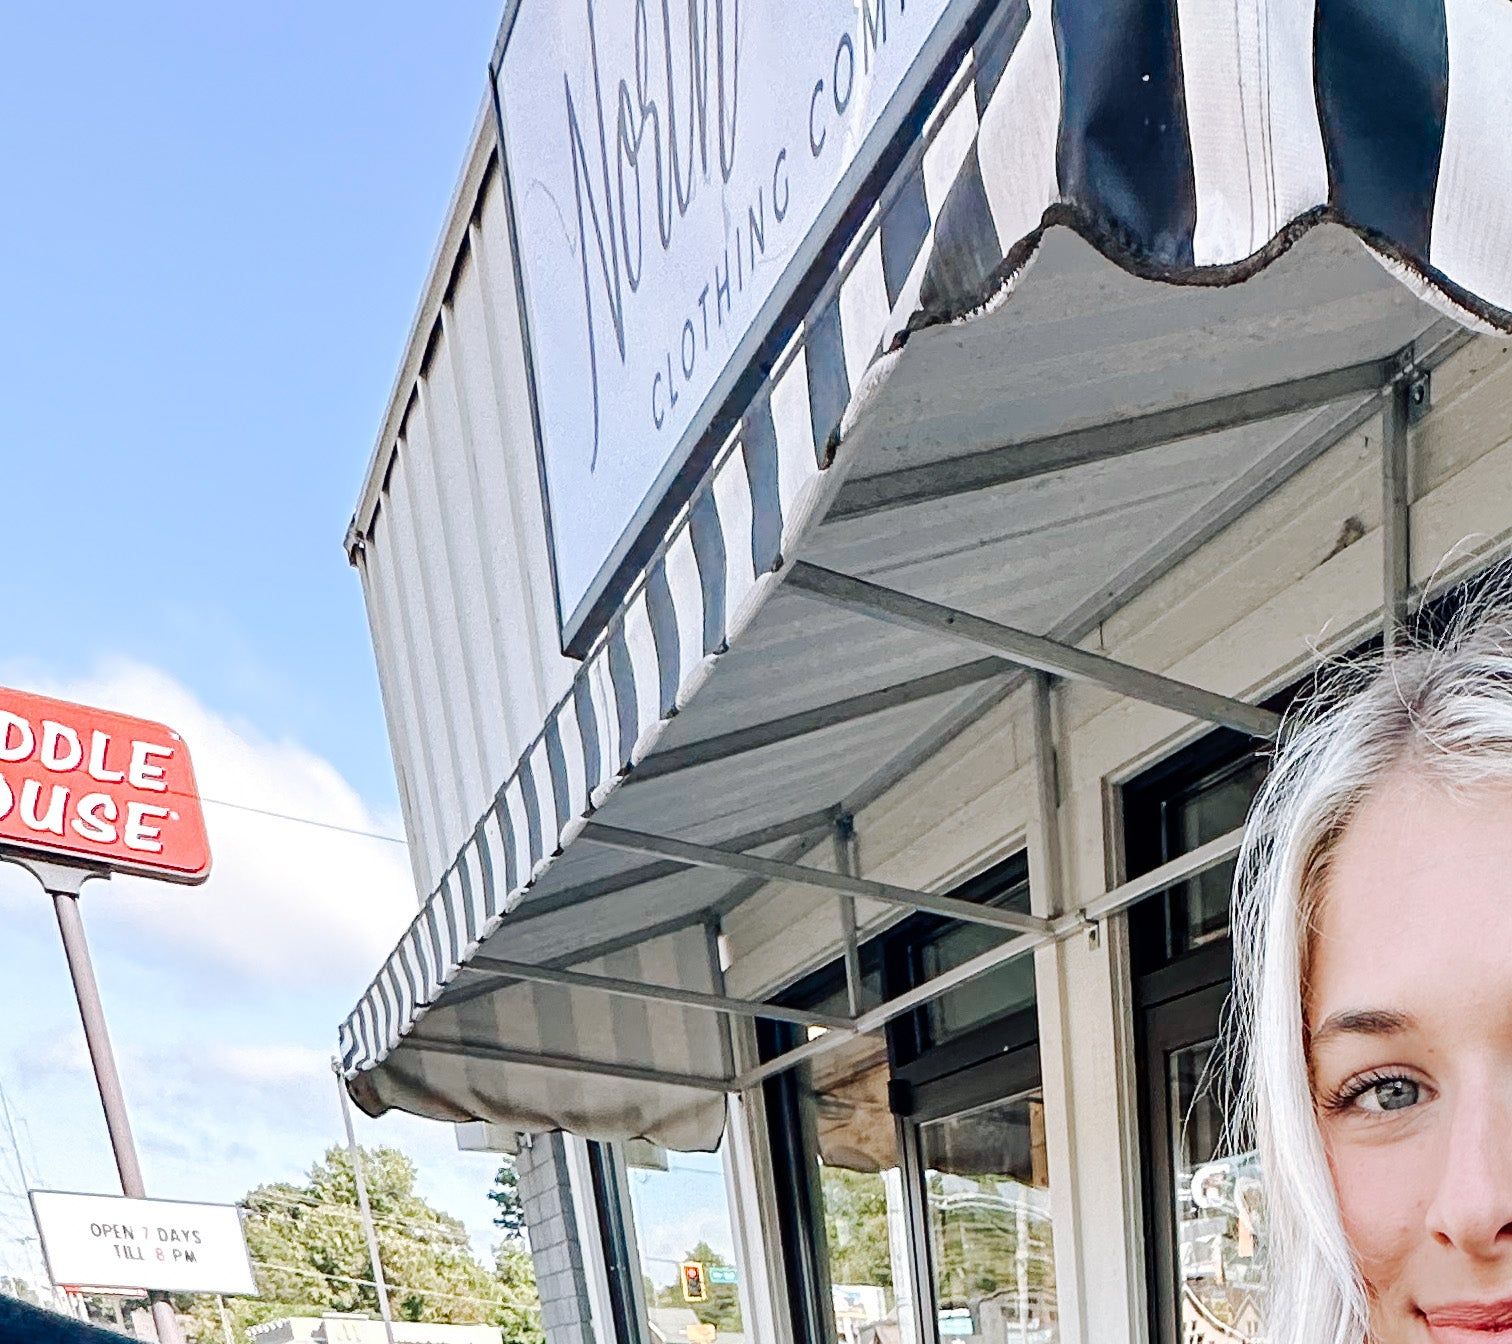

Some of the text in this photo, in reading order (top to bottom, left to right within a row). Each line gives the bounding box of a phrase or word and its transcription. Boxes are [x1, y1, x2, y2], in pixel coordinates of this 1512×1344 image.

[652, 0, 905, 430] CLOTHING COM
[90, 1223, 202, 1244] OPEN 7 DAYS
[114, 1244, 197, 1263] TILL 8 PM
